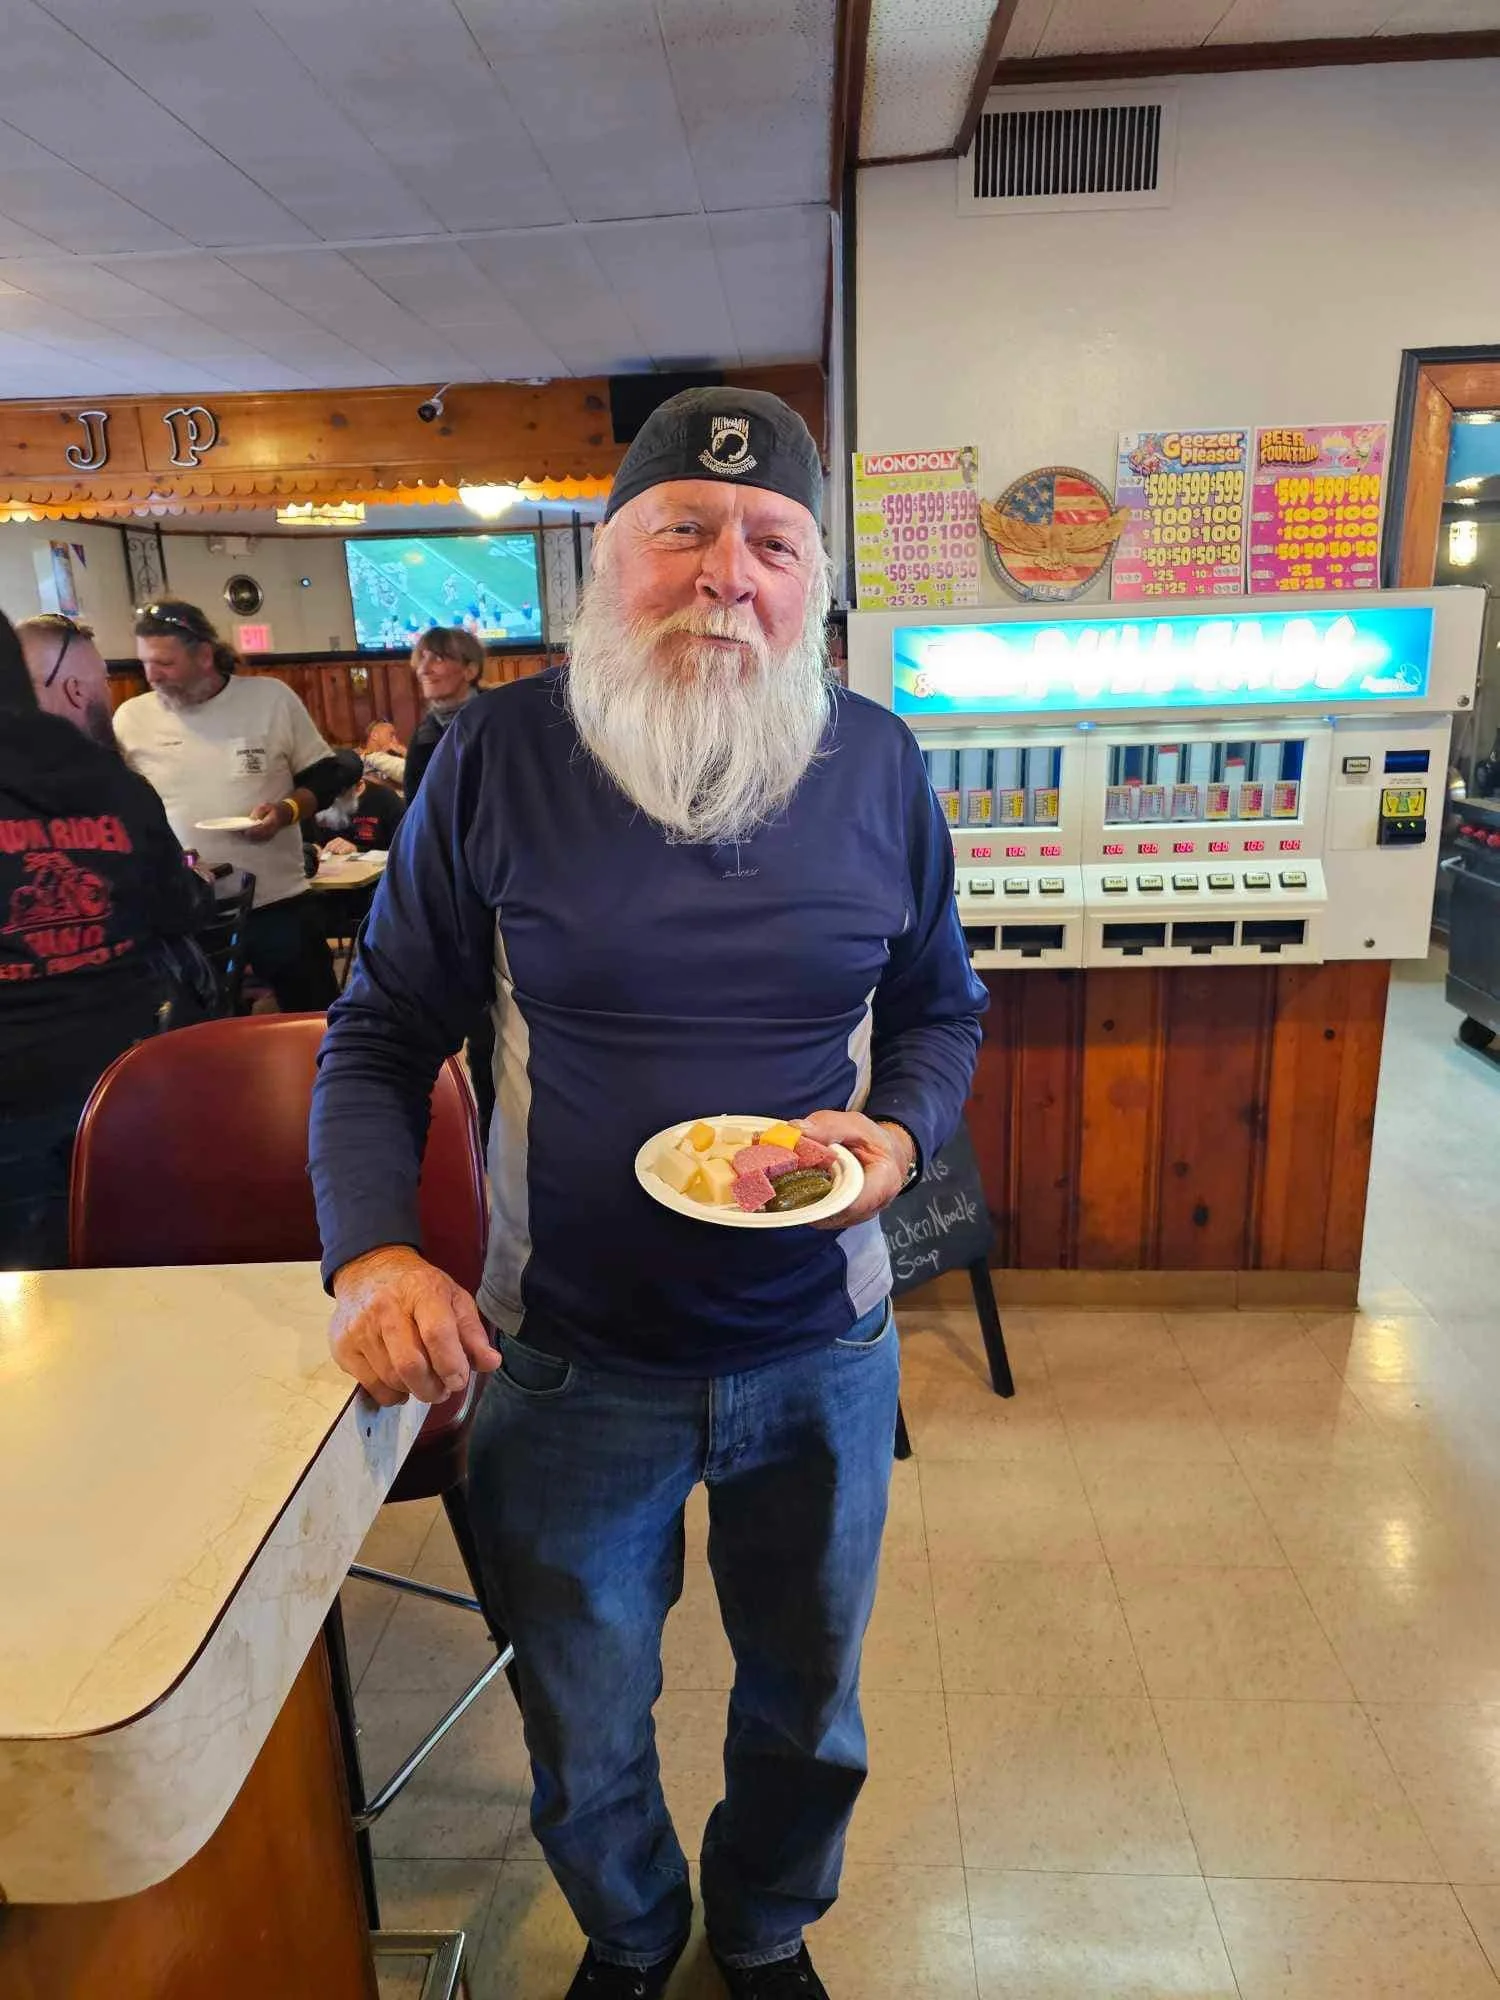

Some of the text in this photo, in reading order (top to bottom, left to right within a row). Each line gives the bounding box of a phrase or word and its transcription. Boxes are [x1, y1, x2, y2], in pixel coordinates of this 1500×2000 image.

[66, 406, 216, 470] J P
[1162, 431, 1244, 459] Geezer
[1261, 431, 1304, 448] BEER
[867, 452, 957, 474] MONOPOLY
[1261, 444, 1319, 466] FOUNTAIN
[1143, 504, 1241, 526] $100 $100
[881, 522, 977, 543] $100 $100
[1142, 524, 1241, 544] $100 $100
[883, 542, 977, 561] $100 $100
[926, 1191, 978, 1236] Noodle
[896, 1249, 939, 1280] Soup
